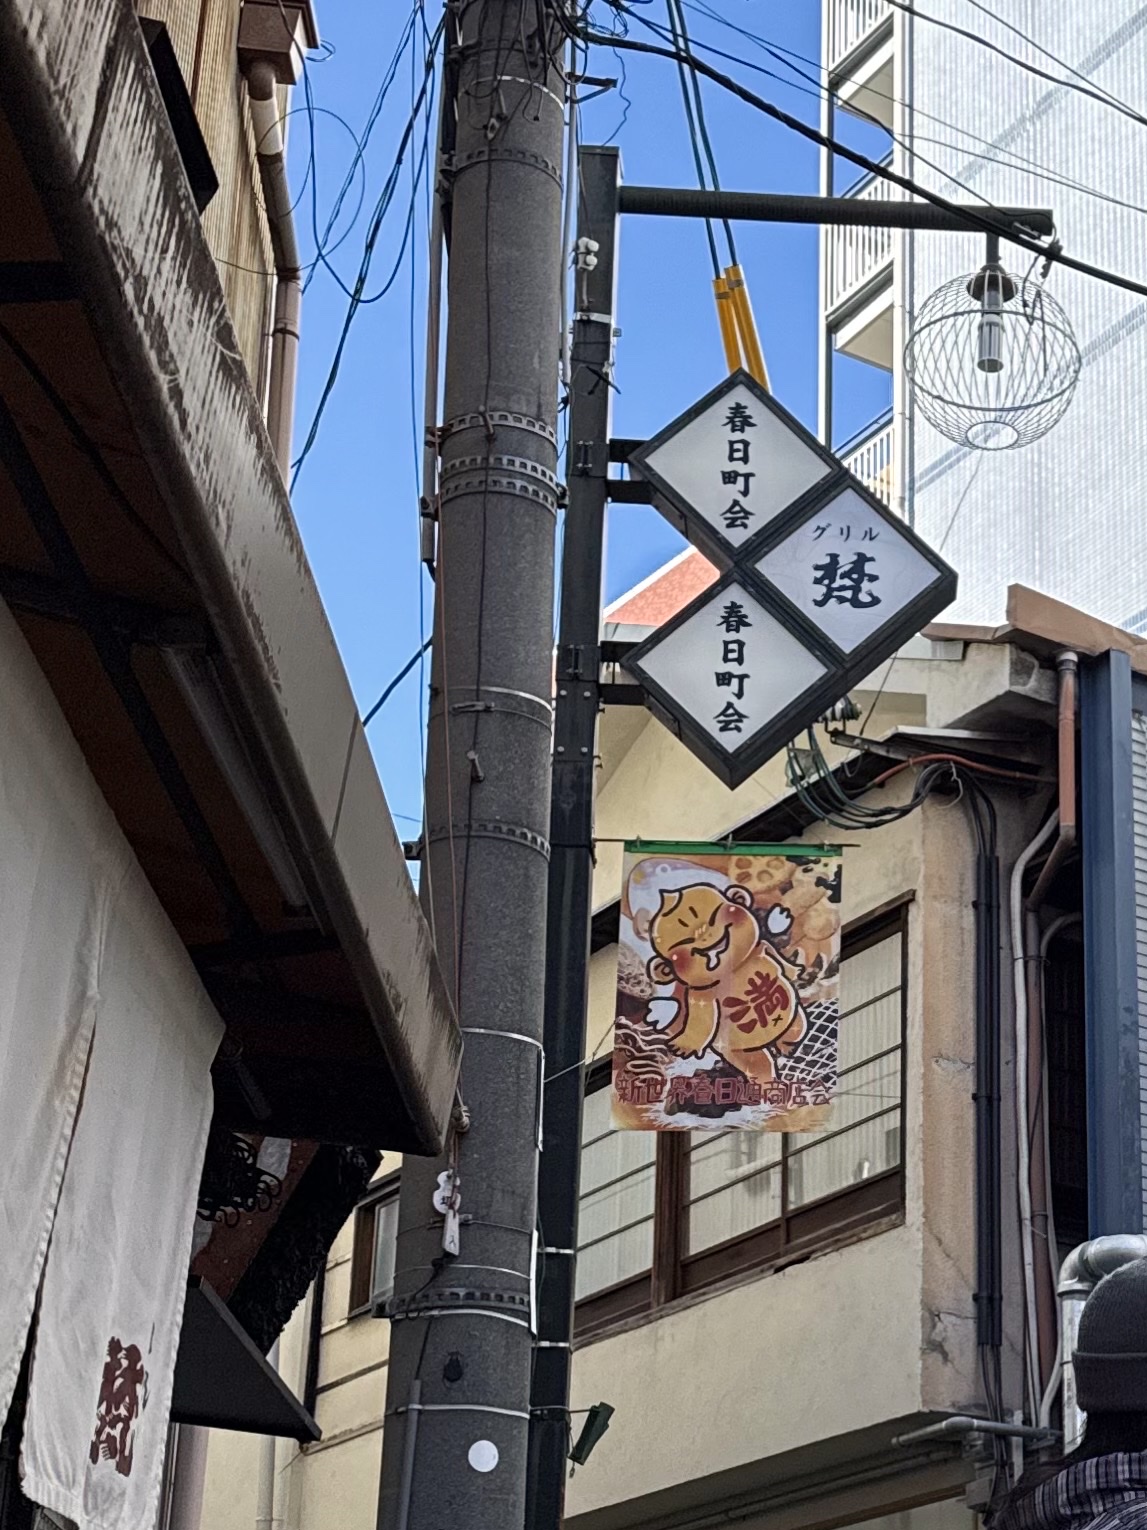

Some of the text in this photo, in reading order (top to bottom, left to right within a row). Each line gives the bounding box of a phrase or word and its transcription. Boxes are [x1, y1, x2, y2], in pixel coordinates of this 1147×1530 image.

[720, 401, 758, 530] 春日町会
[812, 522, 880, 542] グリル
[713, 600, 754, 734] 春日町会
[617, 1074, 832, 1106] 新世界春日通商店会
